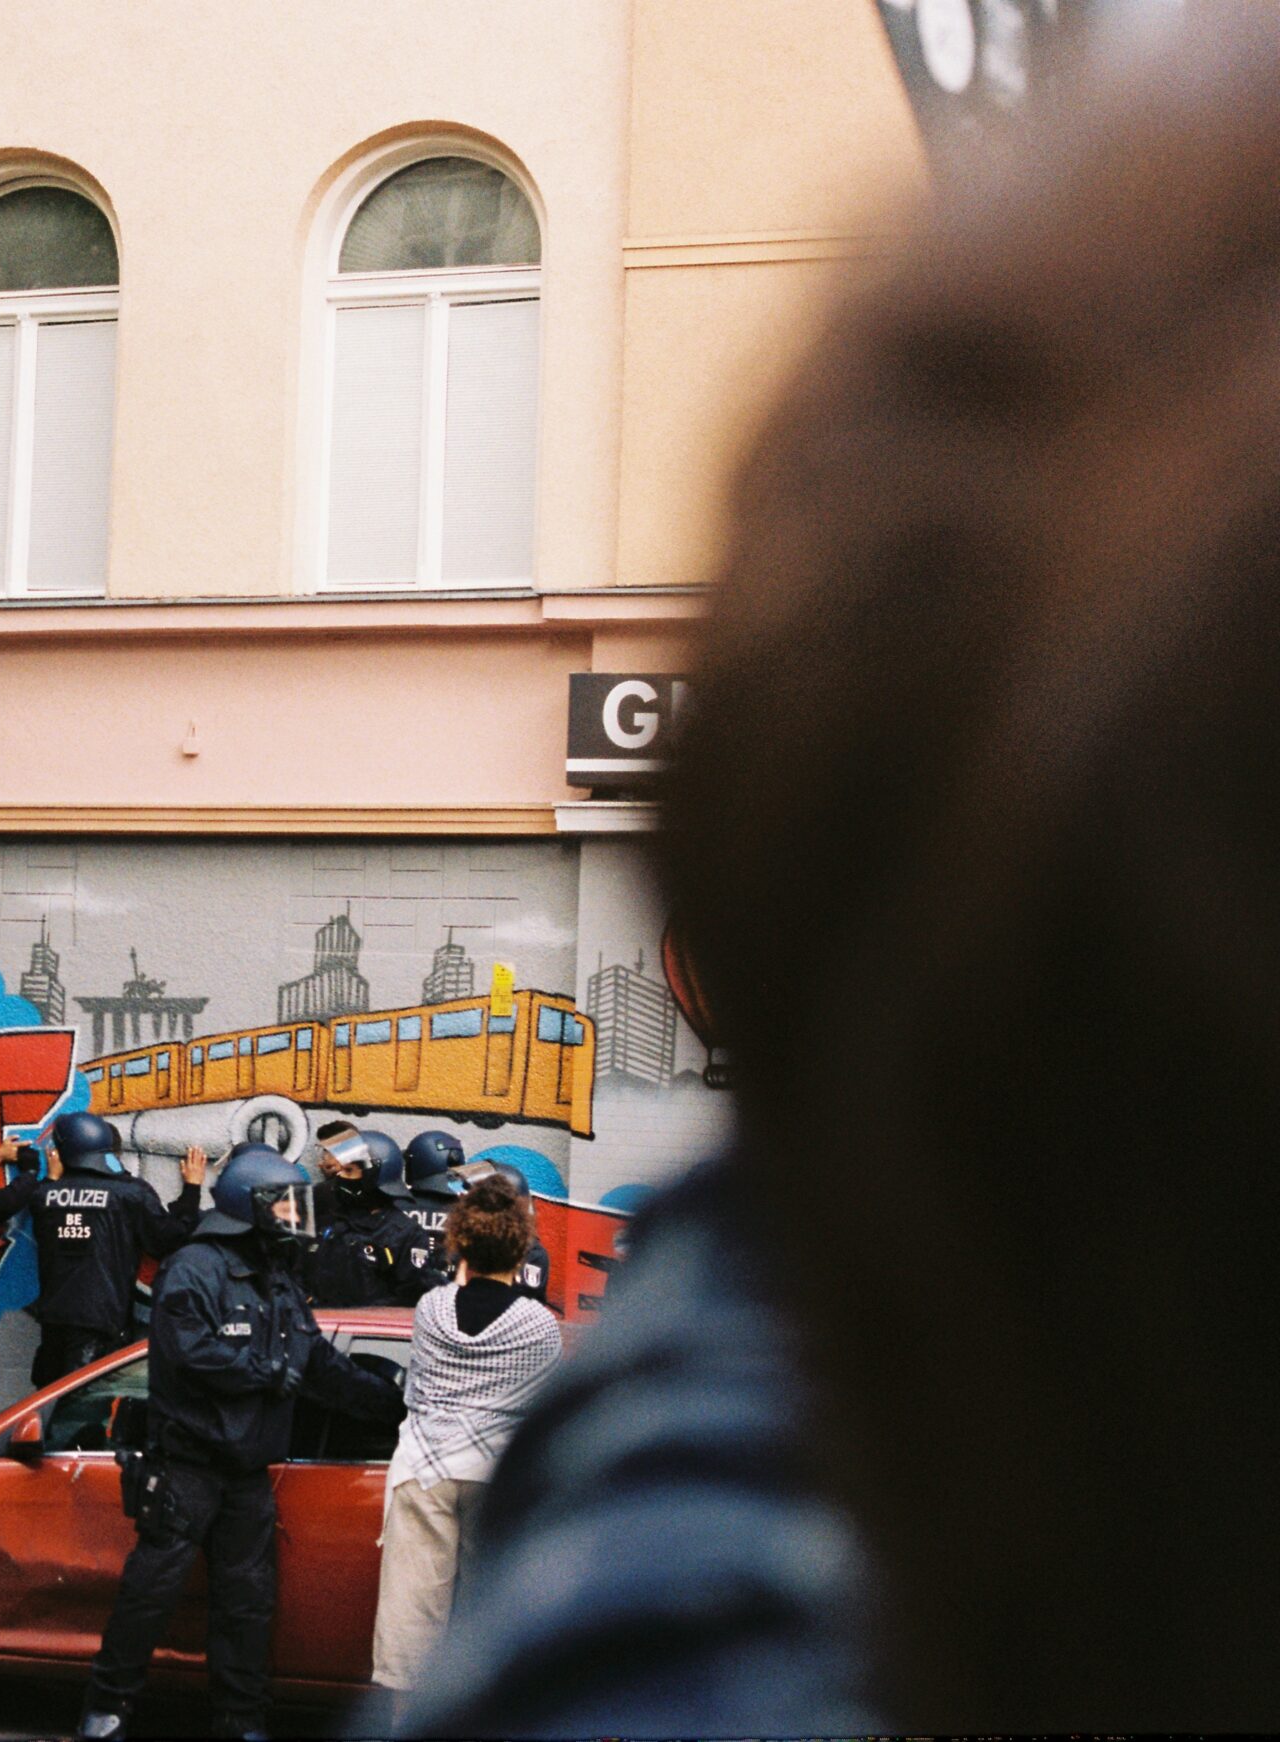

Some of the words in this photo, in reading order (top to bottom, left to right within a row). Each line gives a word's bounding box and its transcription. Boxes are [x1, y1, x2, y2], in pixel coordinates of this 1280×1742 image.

[602, 680, 688, 749] G
[45, 1187, 109, 1208] POLIZEI
[65, 1213, 82, 1226] BE
[57, 1226, 91, 1238] 16325
